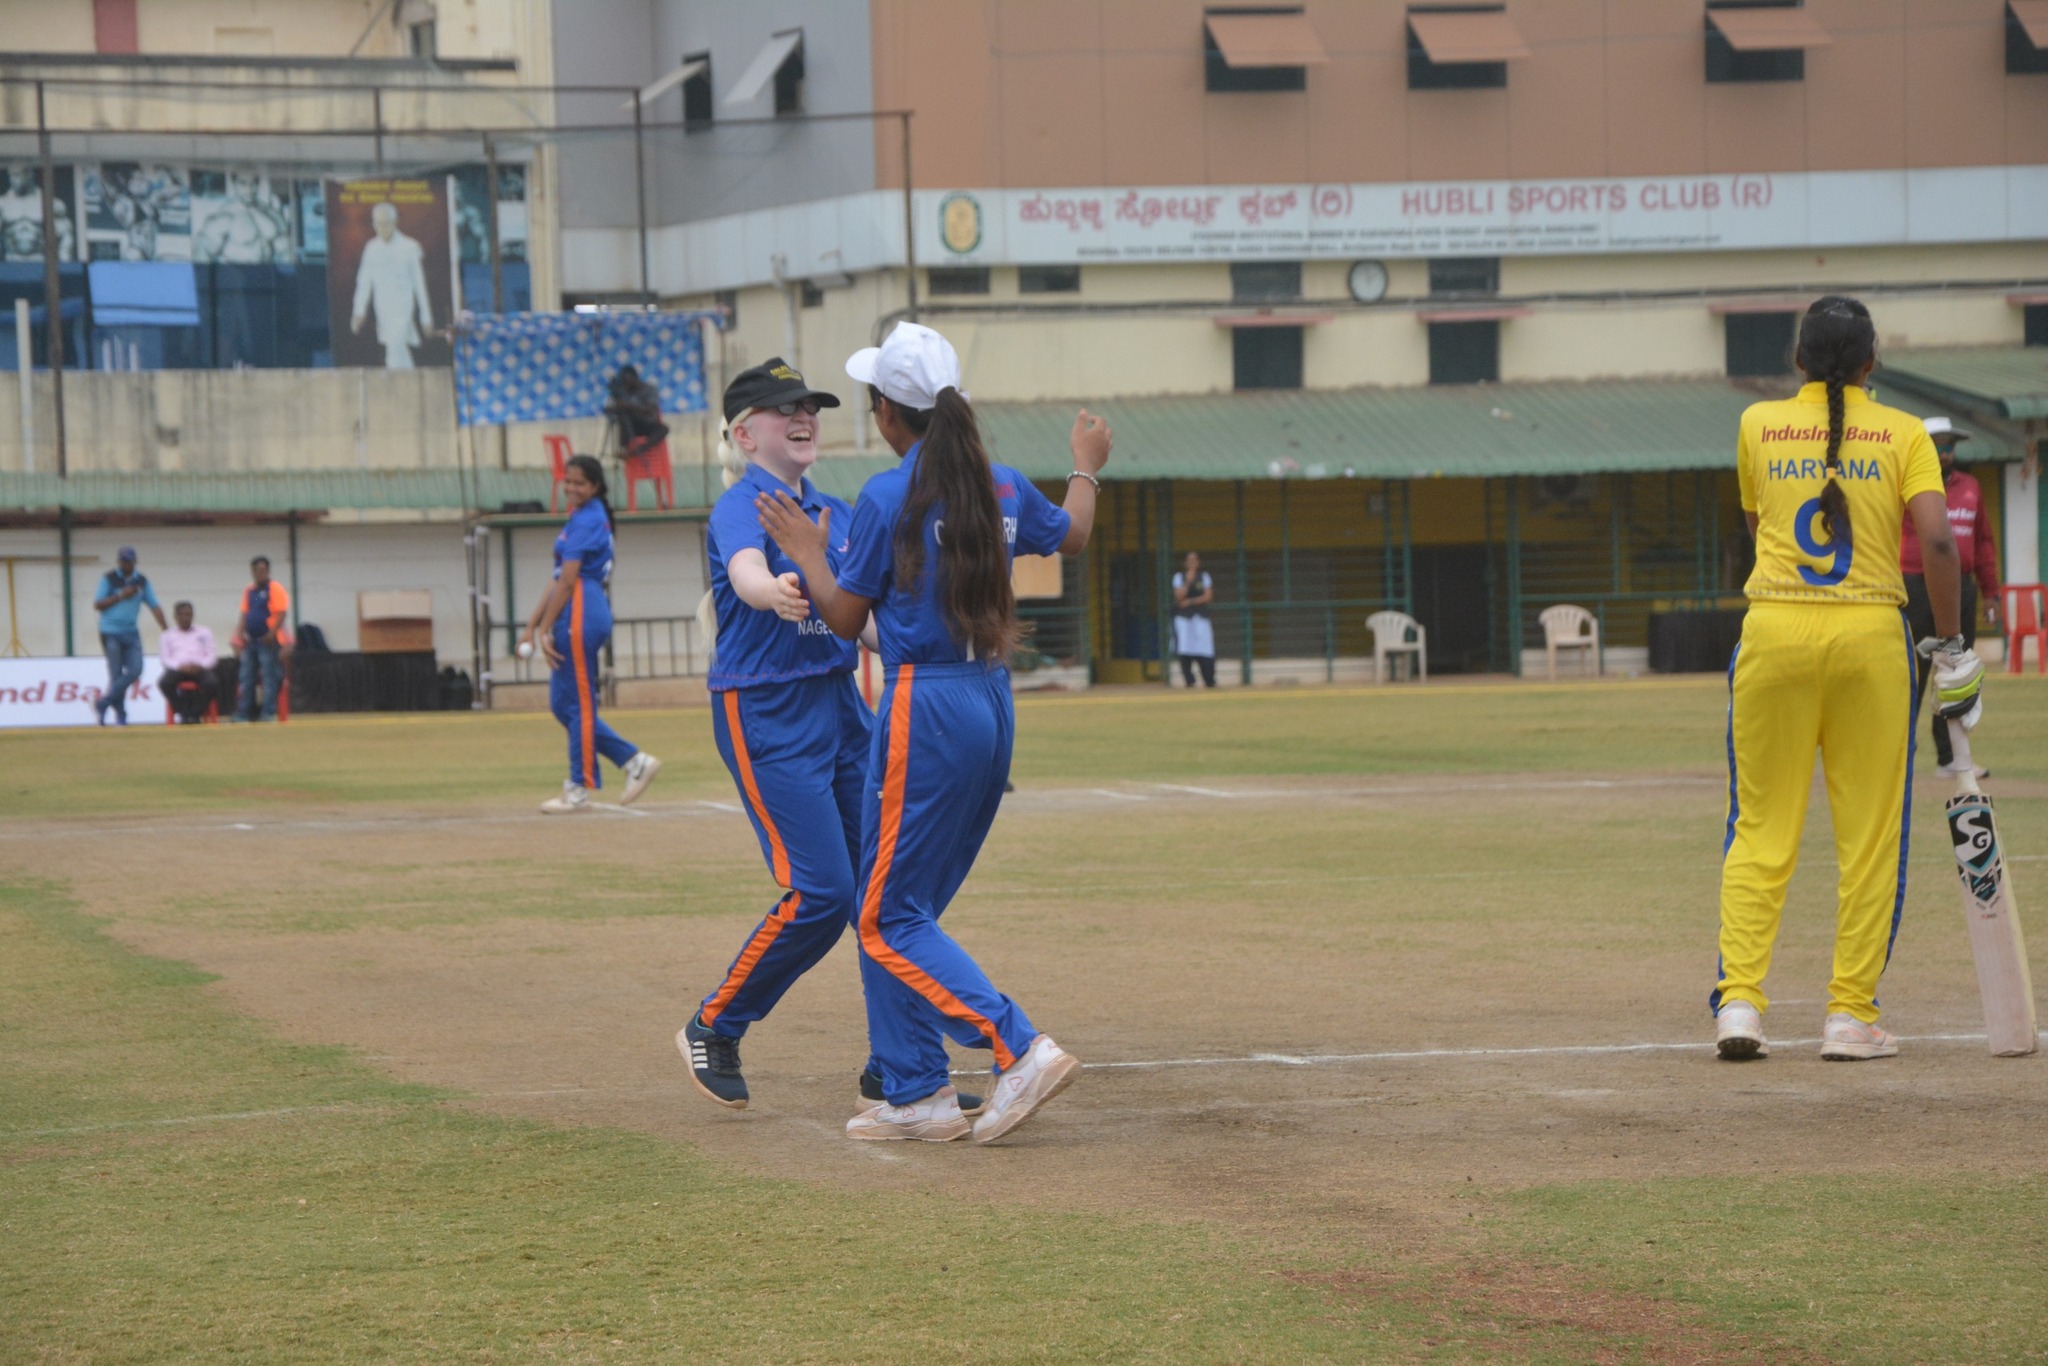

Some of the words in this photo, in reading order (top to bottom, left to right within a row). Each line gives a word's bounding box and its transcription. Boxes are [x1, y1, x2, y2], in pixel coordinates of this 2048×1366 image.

[1401, 185, 1494, 216] HUBLI
[1507, 183, 1628, 213] SPORTS
[1639, 180, 1722, 211] CLUB
[1731, 173, 1774, 208] (R)
[1761, 424, 1831, 443] IndusIn
[1845, 426, 1893, 444] Bank
[1794, 497, 1853, 586] 9
[54, 679, 151, 703] Bak
